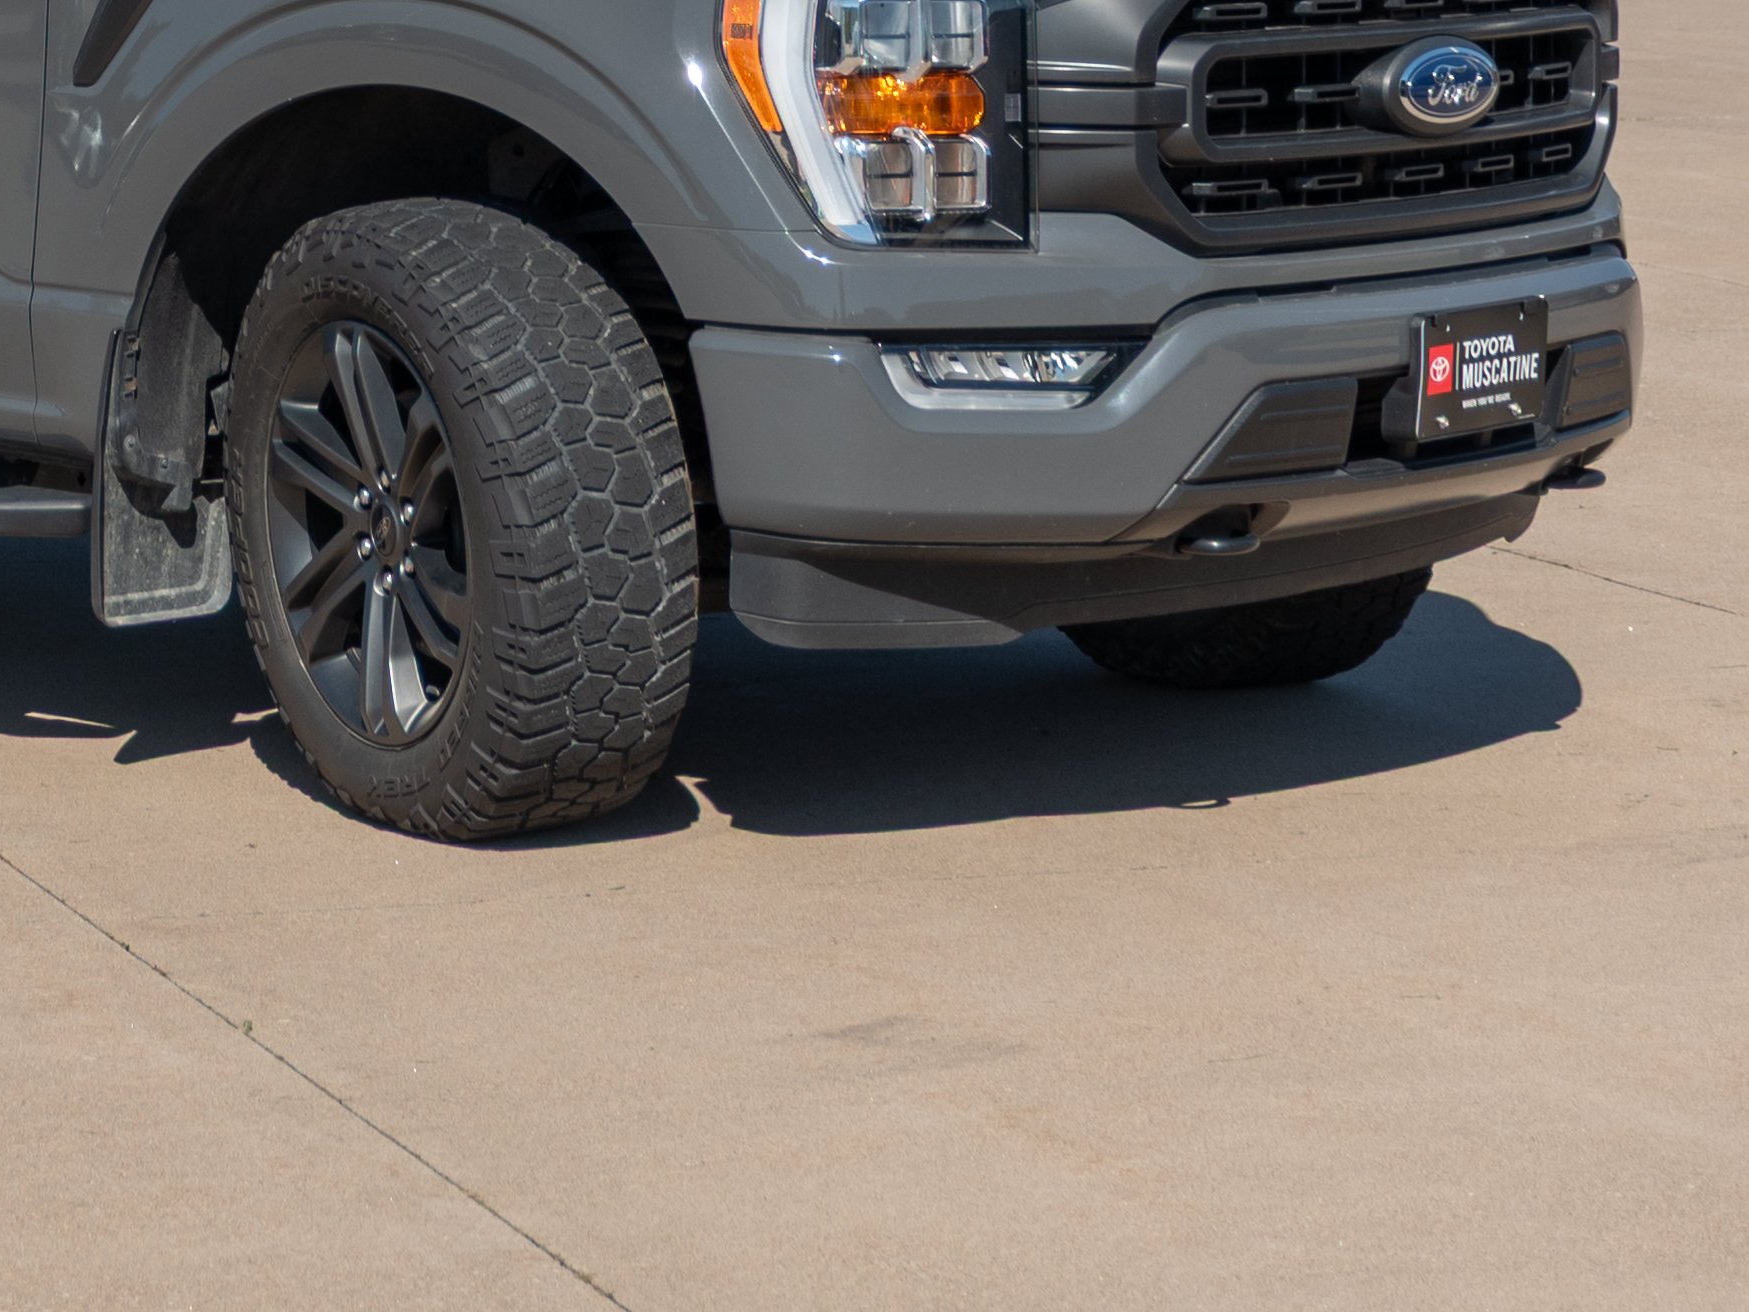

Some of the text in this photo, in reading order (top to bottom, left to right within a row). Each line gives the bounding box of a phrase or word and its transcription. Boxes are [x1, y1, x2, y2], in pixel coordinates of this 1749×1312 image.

[1428, 60, 1483, 106] Ford
[301, 274, 435, 380] DISCOVERER
[1462, 334, 1515, 360] TOYOTA
[1462, 352, 1540, 390] MUSCATINE
